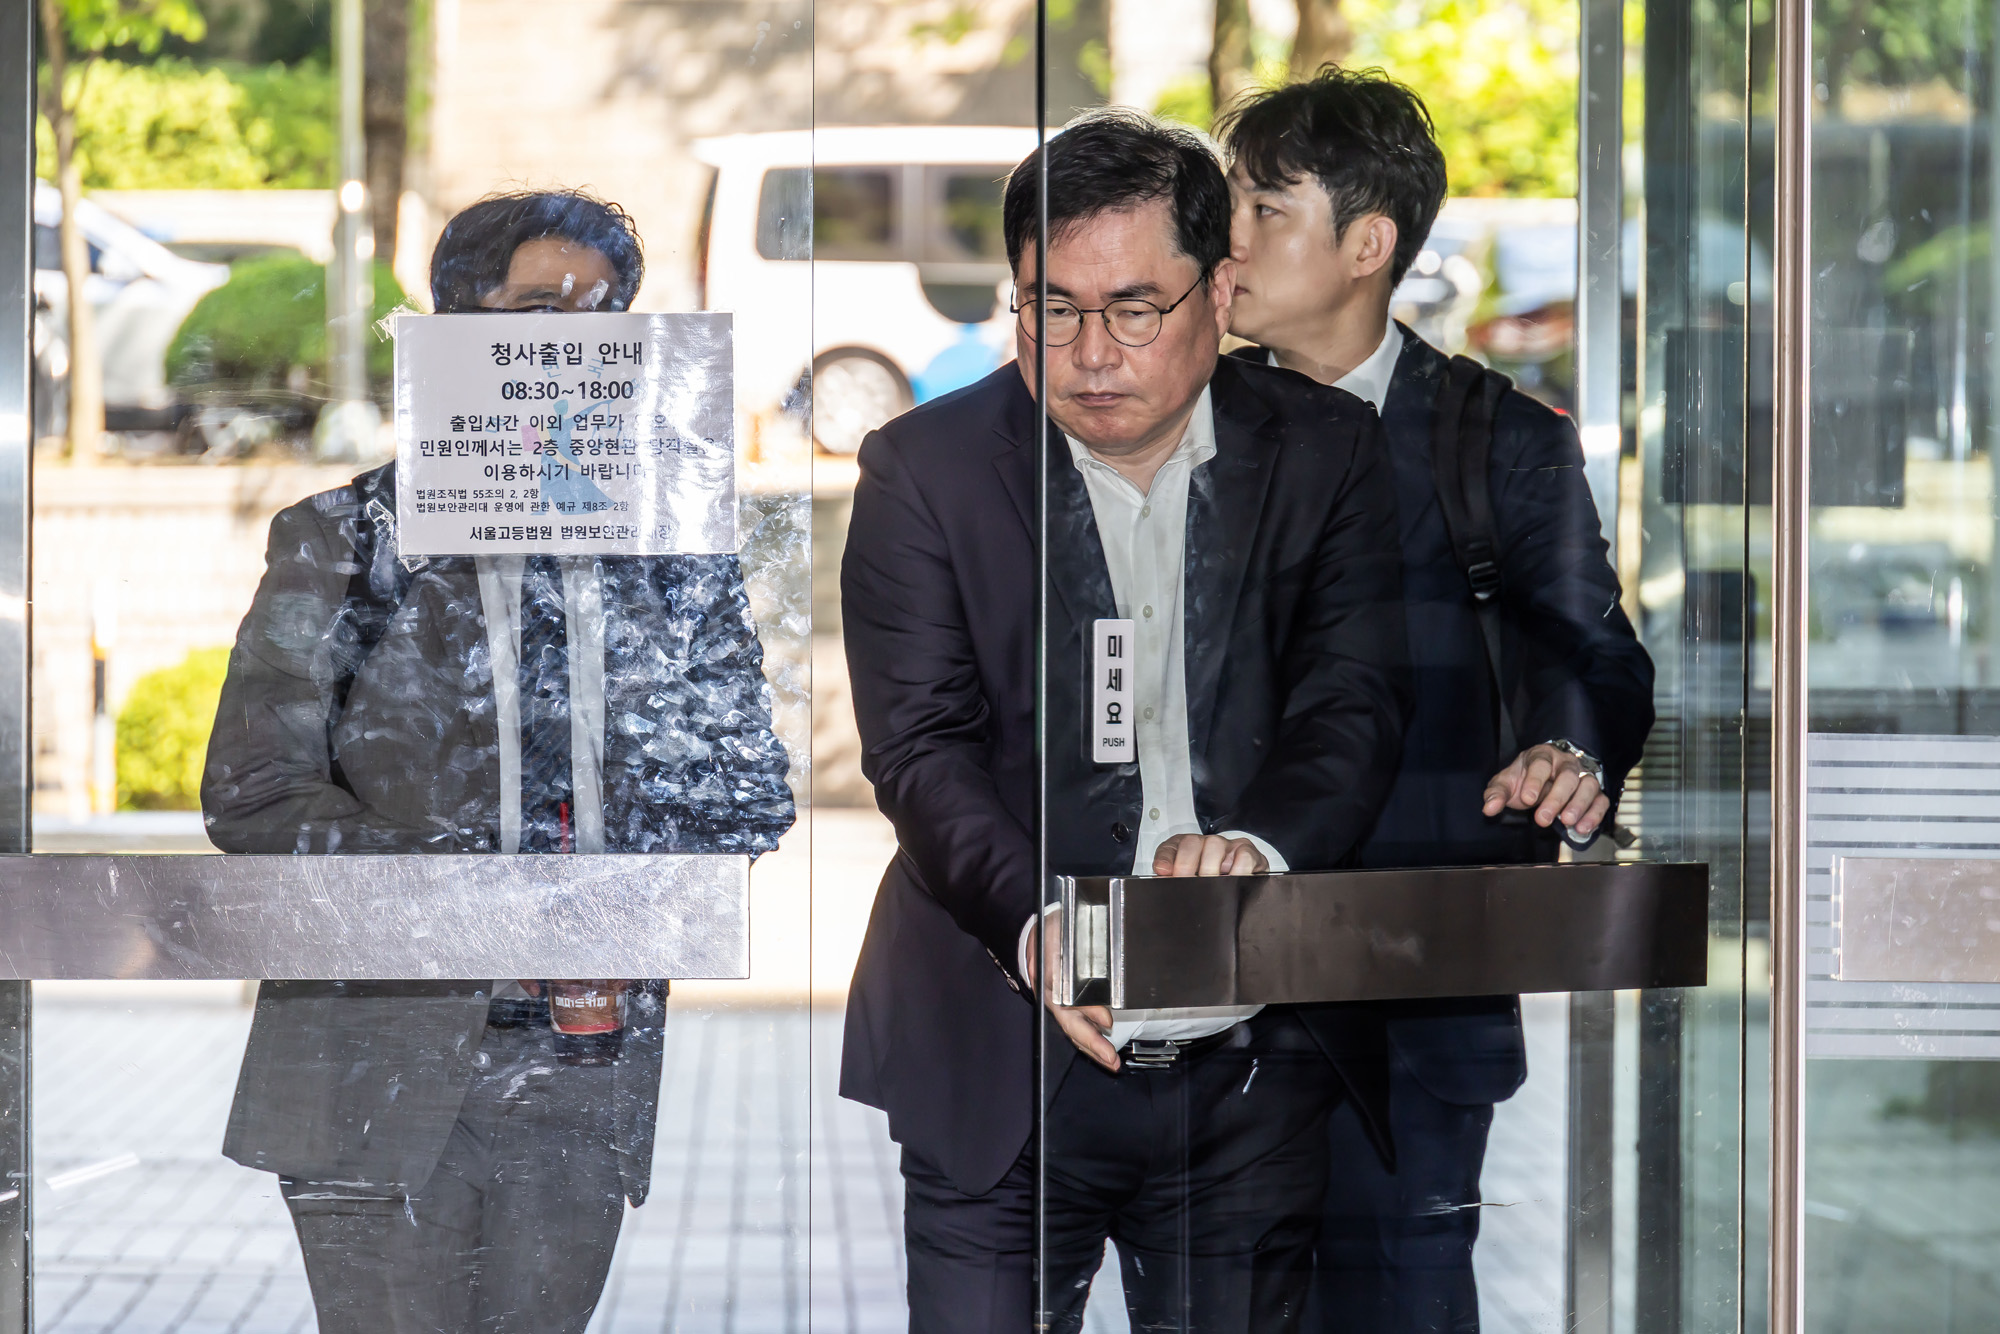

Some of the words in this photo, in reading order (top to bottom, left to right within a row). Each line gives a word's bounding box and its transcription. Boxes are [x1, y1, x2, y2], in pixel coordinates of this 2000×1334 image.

[490, 341, 583, 366] 청사출입
[598, 341, 643, 366] 안내
[501, 381, 634, 400] 08:30~18:00
[449, 414, 520, 432] 출입시간
[529, 414, 562, 432] 이외
[573, 413, 625, 431] 업무가
[420, 439, 523, 457] 민원인께서는
[533, 438, 559, 457] 2층
[569, 437, 636, 456] 중앙현관
[484, 463, 570, 481] 이용하시기
[416, 488, 467, 499] 법원조직법
[472, 488, 505, 499] 55조의
[509, 489, 518, 500] 2,
[523, 488, 539, 499] 2항
[416, 502, 488, 513] 법원보안관리대
[494, 502, 524, 513] 운영에
[530, 502, 551, 512] 관한
[556, 501, 577, 512] 예규
[582, 501, 608, 512] 제8조
[613, 501, 629, 511] 2항
[469, 525, 553, 541] 서울고등법원
[1106, 634, 1123, 725] 미세요
[1102, 737, 1125, 747] PUSH
